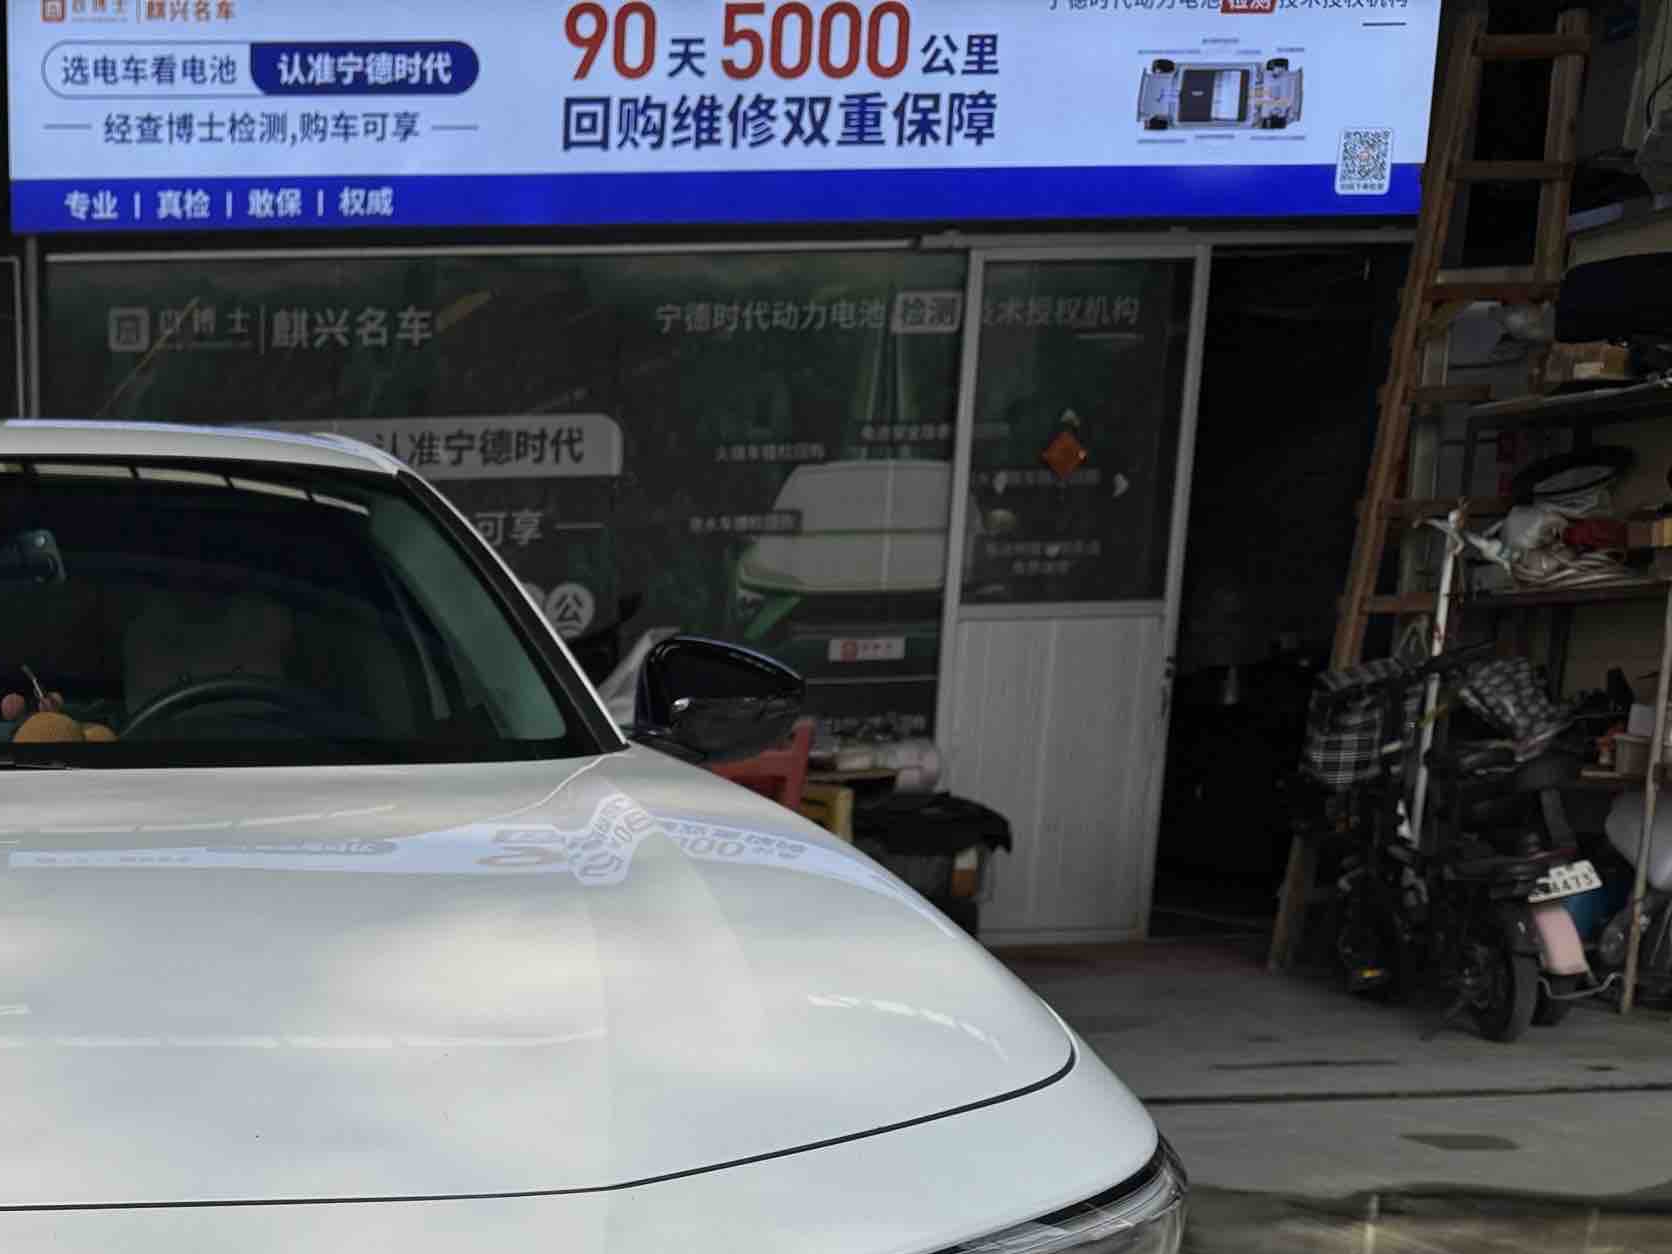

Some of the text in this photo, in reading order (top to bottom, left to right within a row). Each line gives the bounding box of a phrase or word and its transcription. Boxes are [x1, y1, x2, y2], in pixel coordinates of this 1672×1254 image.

[61, 52, 453, 86] 选电车看电池 认准宁德时代
[561, 90, 999, 151] 回购维修双重保障
[64, 187, 395, 220] 专业 真检 敢保 权威
[656, 299, 888, 337] 宁德时代动力电池
[473, 509, 546, 547] 可享
